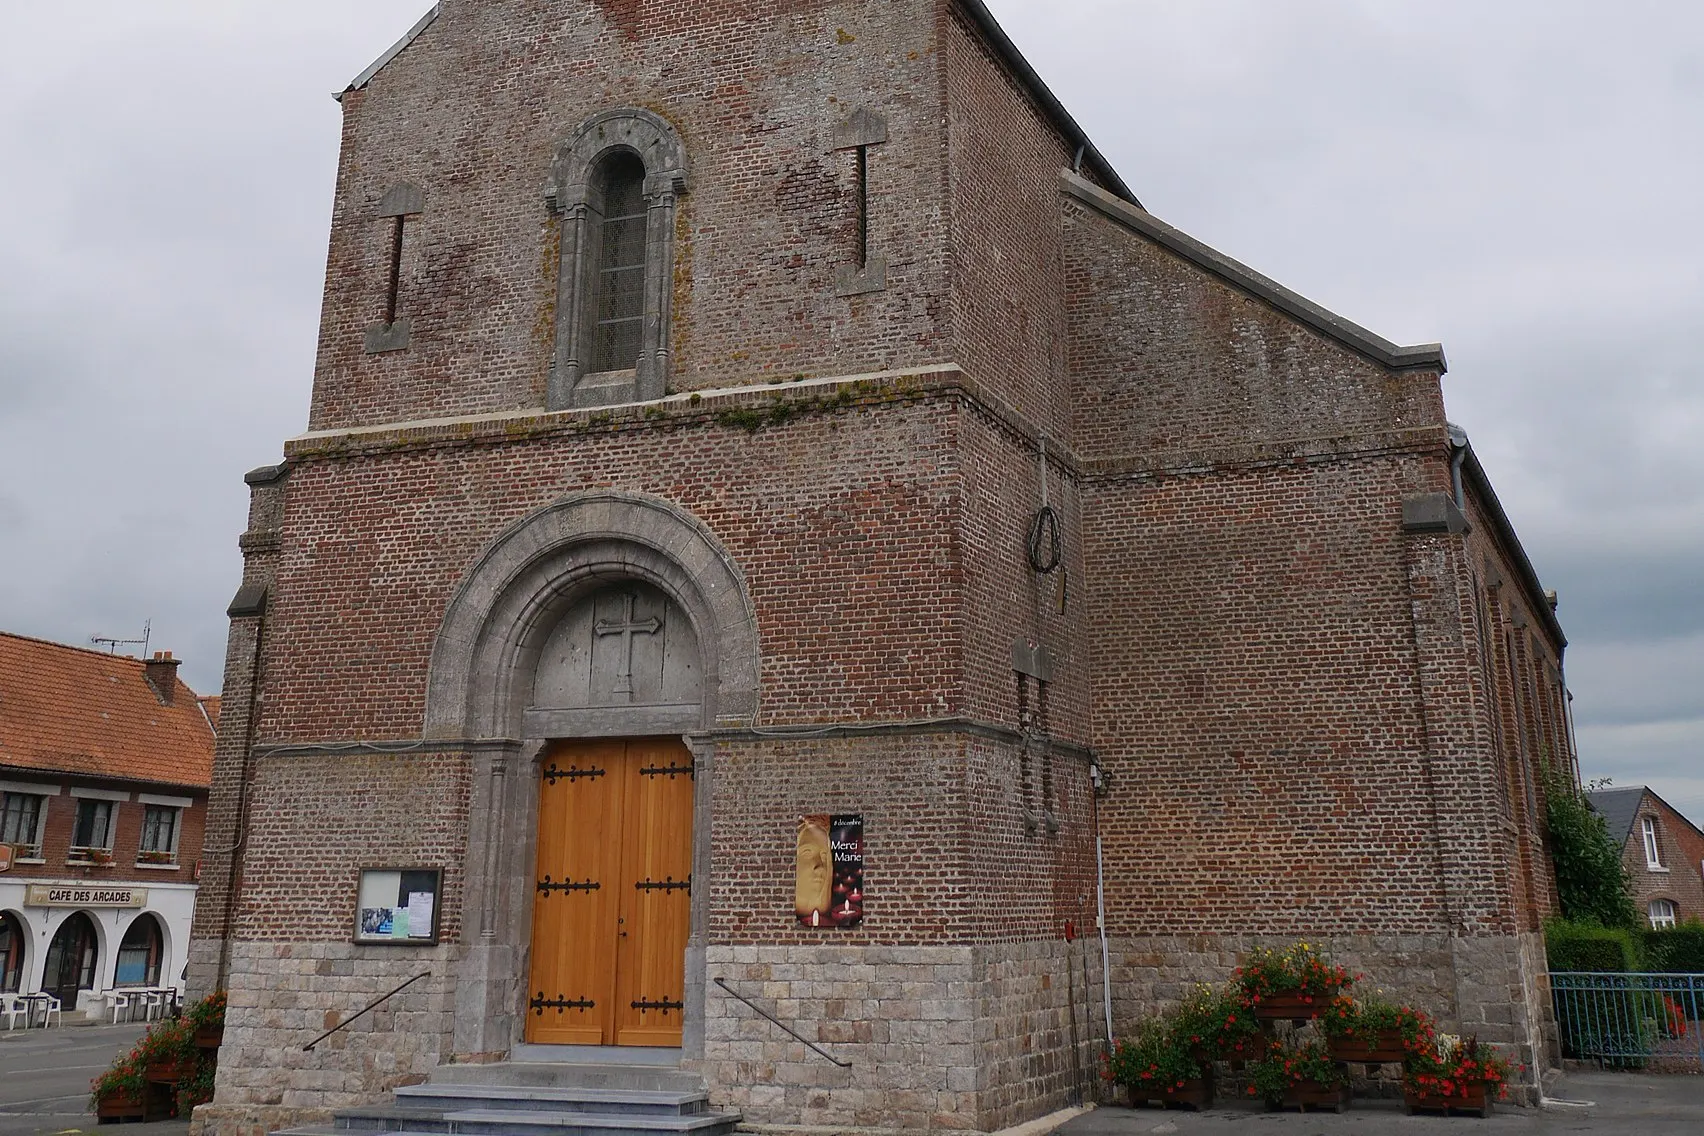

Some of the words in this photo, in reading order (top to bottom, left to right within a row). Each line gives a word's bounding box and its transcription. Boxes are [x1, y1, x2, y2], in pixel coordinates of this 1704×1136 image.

[831, 840, 858, 850] Merci
[835, 852, 862, 862] Marie
[73, 891, 90, 902] DES
[92, 891, 131, 902] ARCADES
